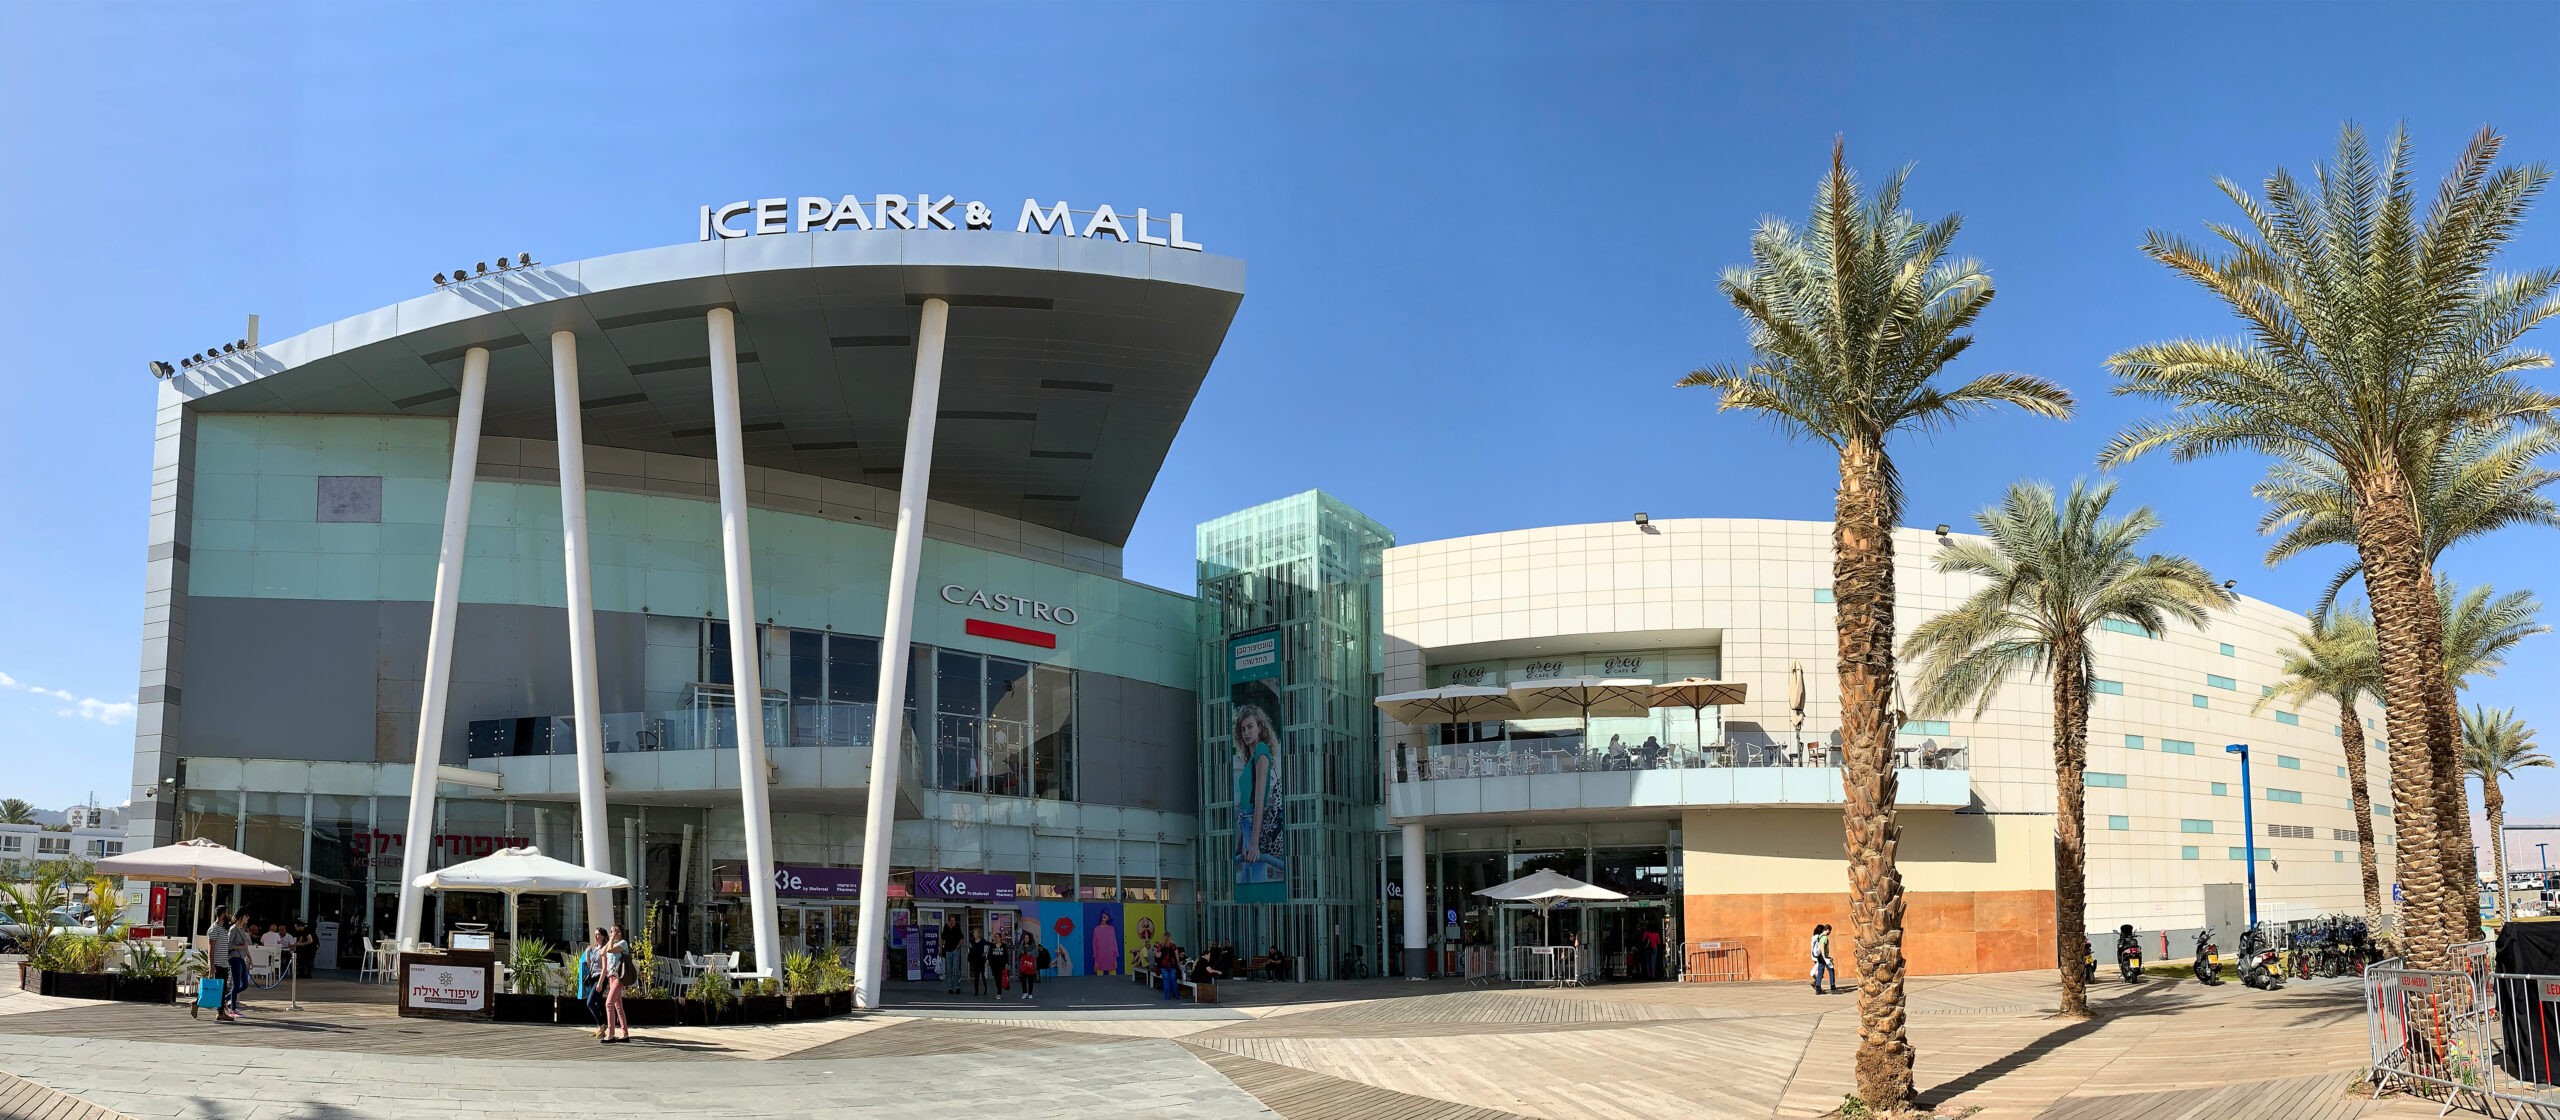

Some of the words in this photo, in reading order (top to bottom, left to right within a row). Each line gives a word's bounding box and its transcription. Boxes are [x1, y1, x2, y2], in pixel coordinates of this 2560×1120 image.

[966, 201, 992, 230] &
[1017, 198, 1203, 252] MALL
[941, 584, 1079, 625] CASTRO
[1525, 660, 1565, 679] greg
[1604, 656, 1643, 674] greg
[1452, 667, 1488, 685] greg
[352, 828, 404, 855] ילת
[413, 985, 440, 997] אילת
[2401, 976, 2428, 988] LED-MEDIA
[444, 988, 479, 999] שיפודי
